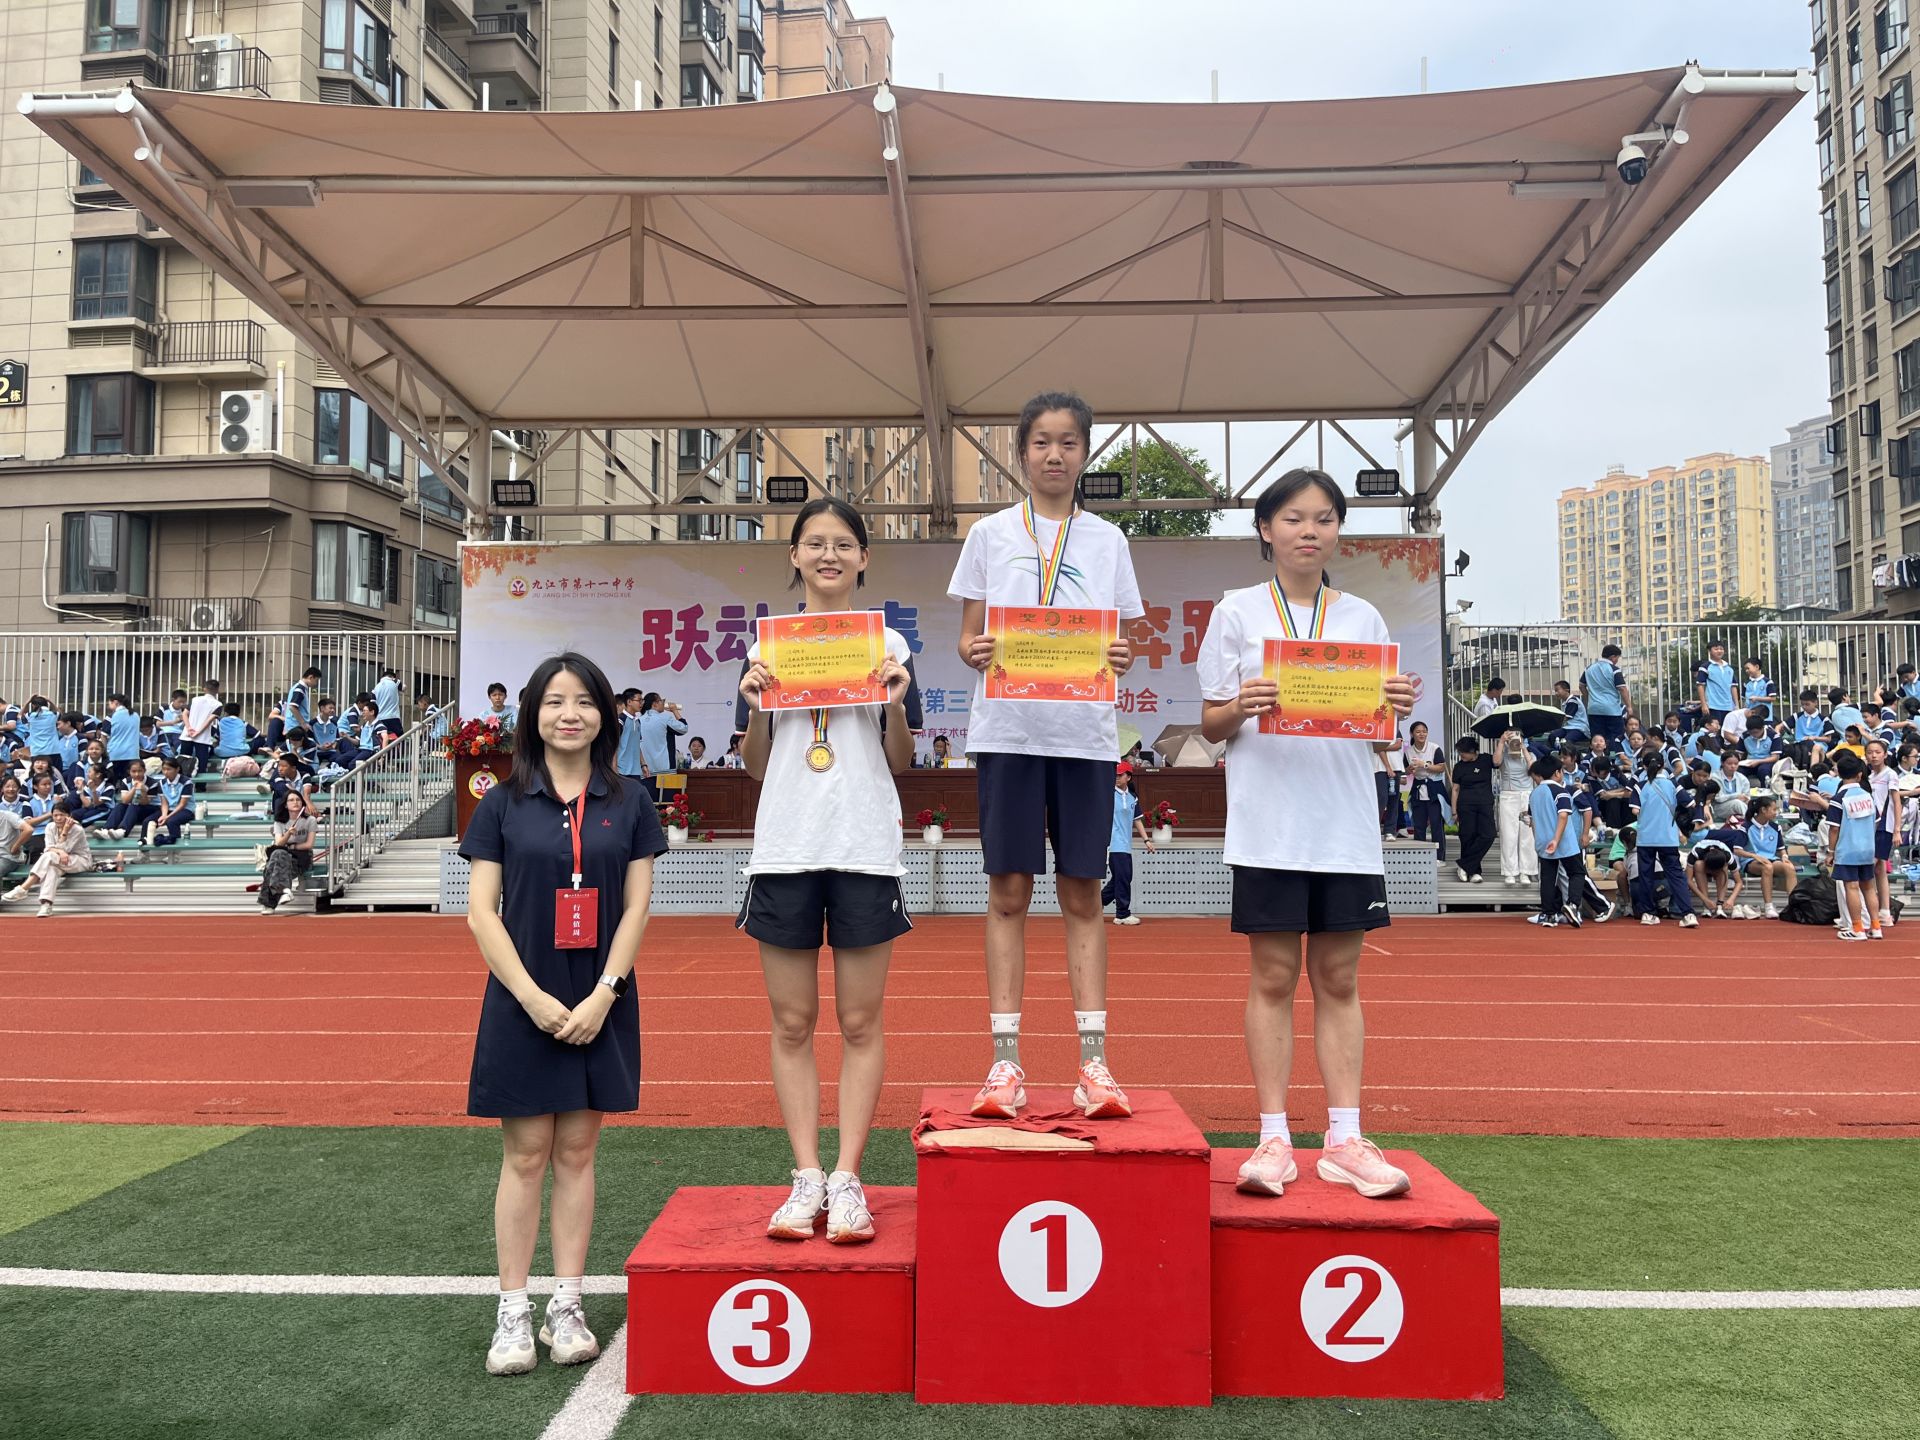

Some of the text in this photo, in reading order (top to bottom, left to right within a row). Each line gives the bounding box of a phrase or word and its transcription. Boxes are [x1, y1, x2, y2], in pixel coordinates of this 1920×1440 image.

[532, 577, 634, 590] 九江市第十一中学
[1030, 1214, 1067, 1293] 1
[732, 1288, 791, 1369] 3
[1324, 1266, 1385, 1345] 2
